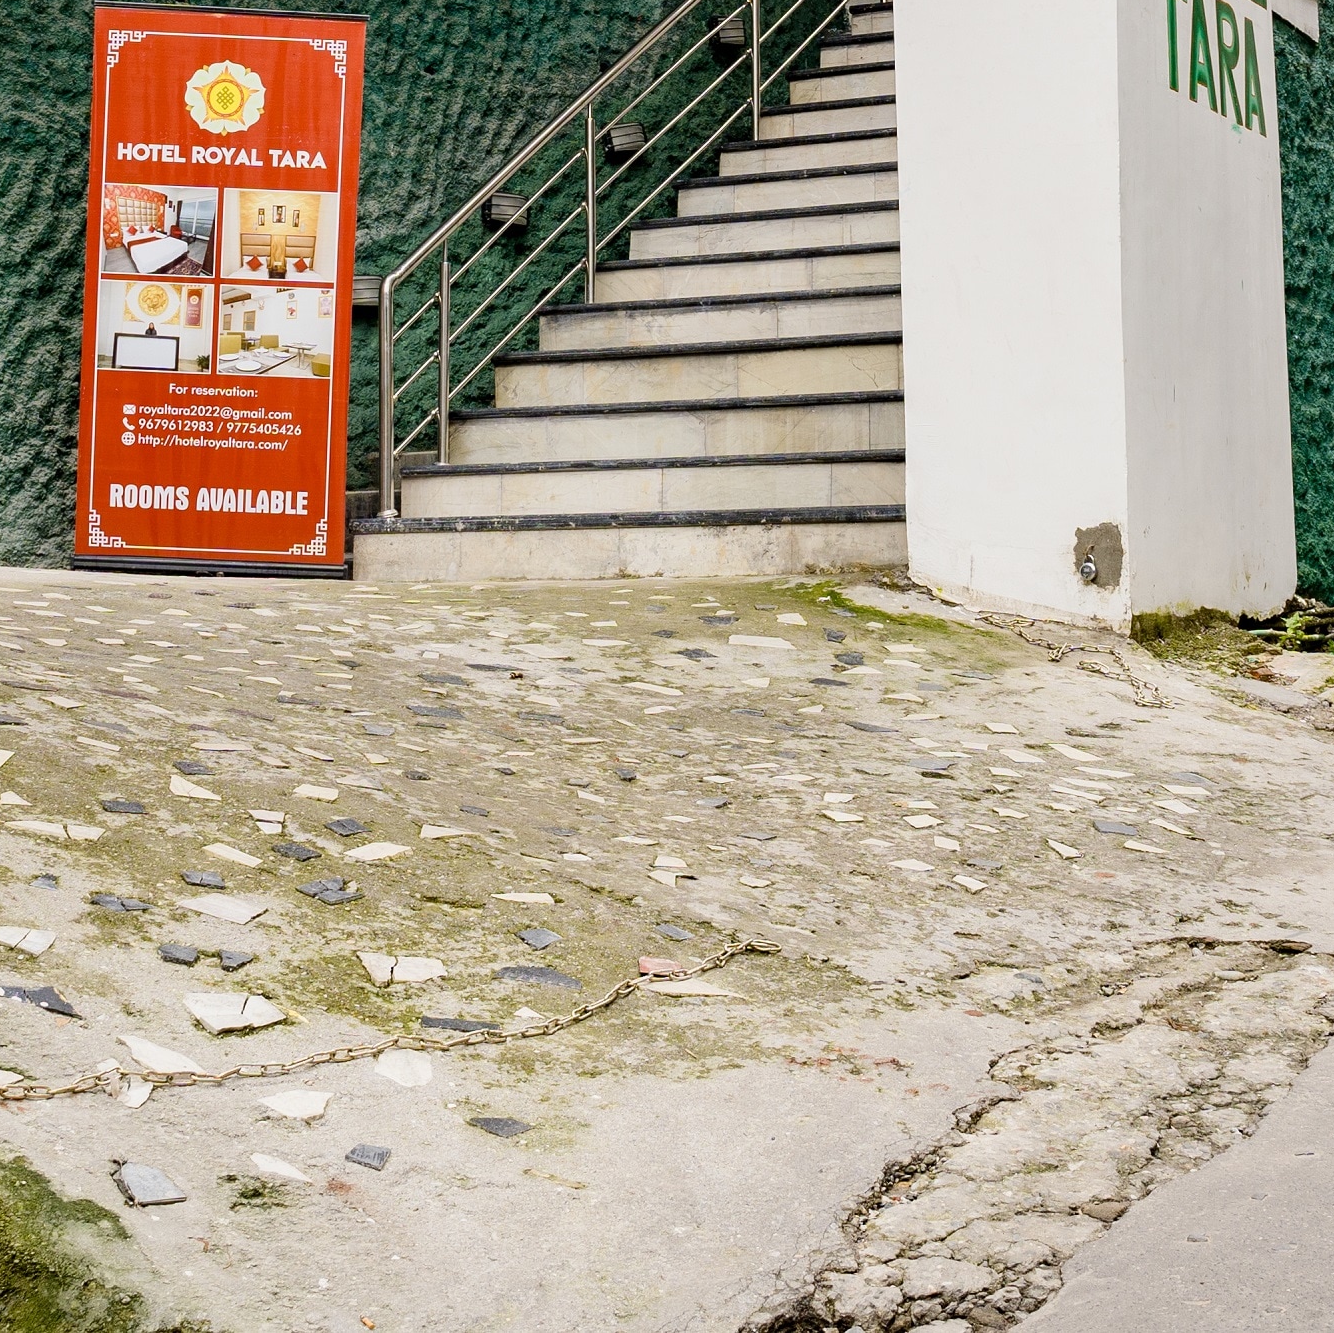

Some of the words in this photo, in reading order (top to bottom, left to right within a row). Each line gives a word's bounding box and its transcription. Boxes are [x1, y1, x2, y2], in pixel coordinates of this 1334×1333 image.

[117, 142, 186, 164] HOTEL
[191, 145, 264, 167] ROYAL
[268, 149, 327, 169] TARA
[169, 383, 188, 395] For
[191, 384, 258, 398] reservation:
[138, 404, 293, 421] royaltara2022@gmail.com
[138, 418, 214, 432] 9679612983
[216, 421, 224, 434] /
[226, 422, 302, 436] 9775405426
[138, 433, 289, 451] http://hotelroyaltara.com/
[109, 483, 190, 510] ROOMS
[195, 487, 309, 515] AVAILABLE
